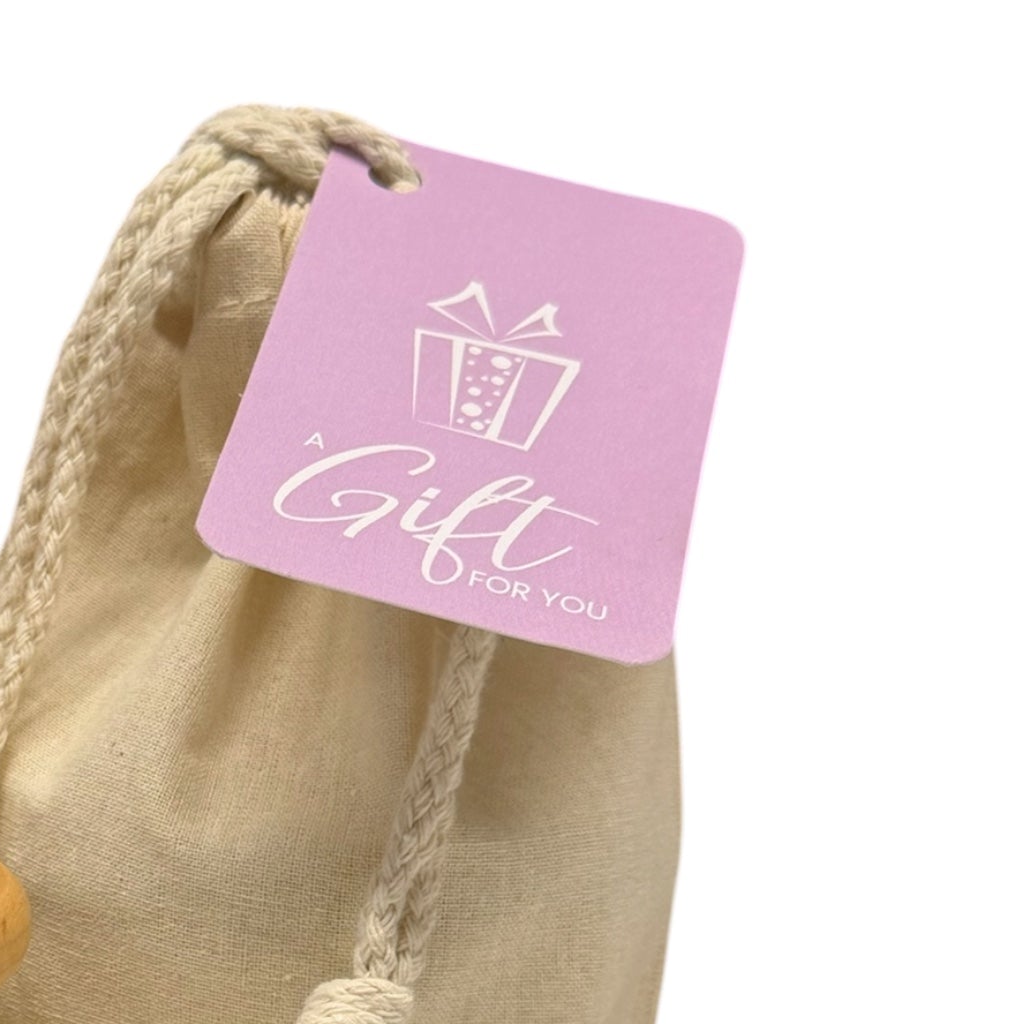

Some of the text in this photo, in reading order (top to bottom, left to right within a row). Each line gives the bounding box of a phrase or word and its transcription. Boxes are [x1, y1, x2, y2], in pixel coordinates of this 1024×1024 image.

[303, 432, 325, 450] A
[273, 444, 600, 585] Gift
[468, 569, 609, 622] FOR YOU
